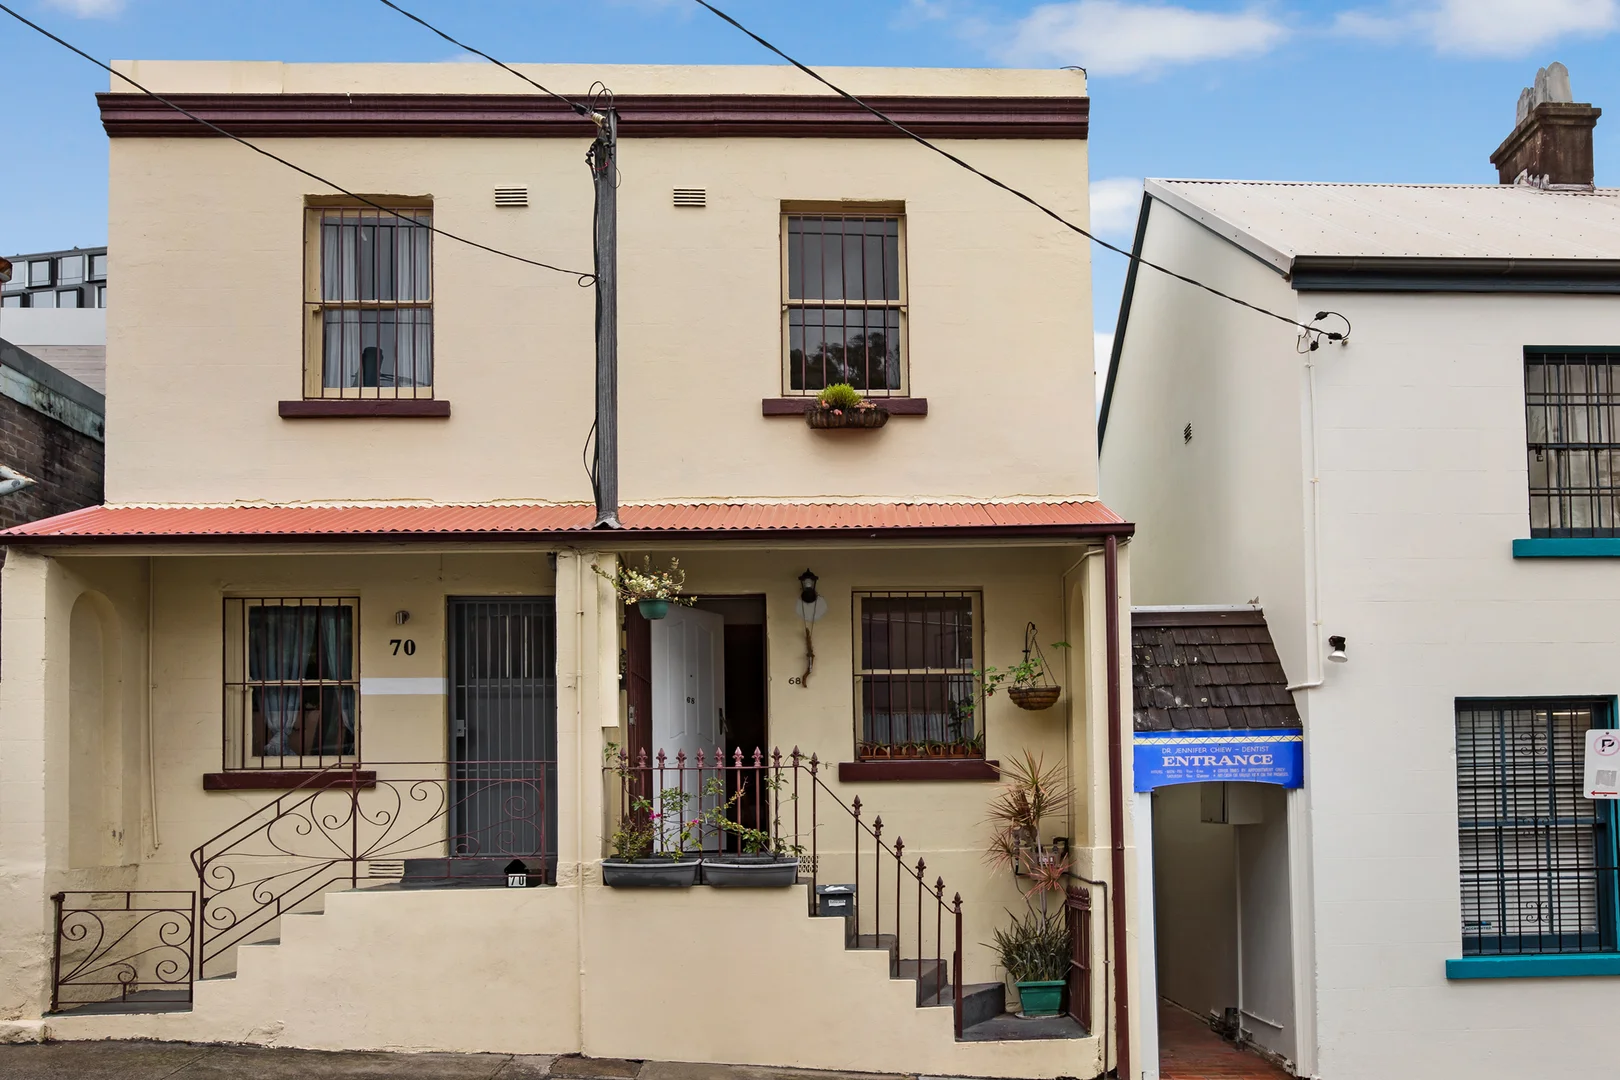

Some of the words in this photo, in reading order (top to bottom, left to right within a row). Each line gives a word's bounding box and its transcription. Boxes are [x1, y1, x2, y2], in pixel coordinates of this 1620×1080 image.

[389, 639, 416, 656] 70
[788, 676, 801, 685] 68
[686, 696, 695, 705] 68
[1174, 747, 1207, 755] JENNIFER
[1241, 745, 1270, 753] DENTIST
[1601, 739, 1615, 752] P
[1162, 754, 1273, 767] ENTRANCE
